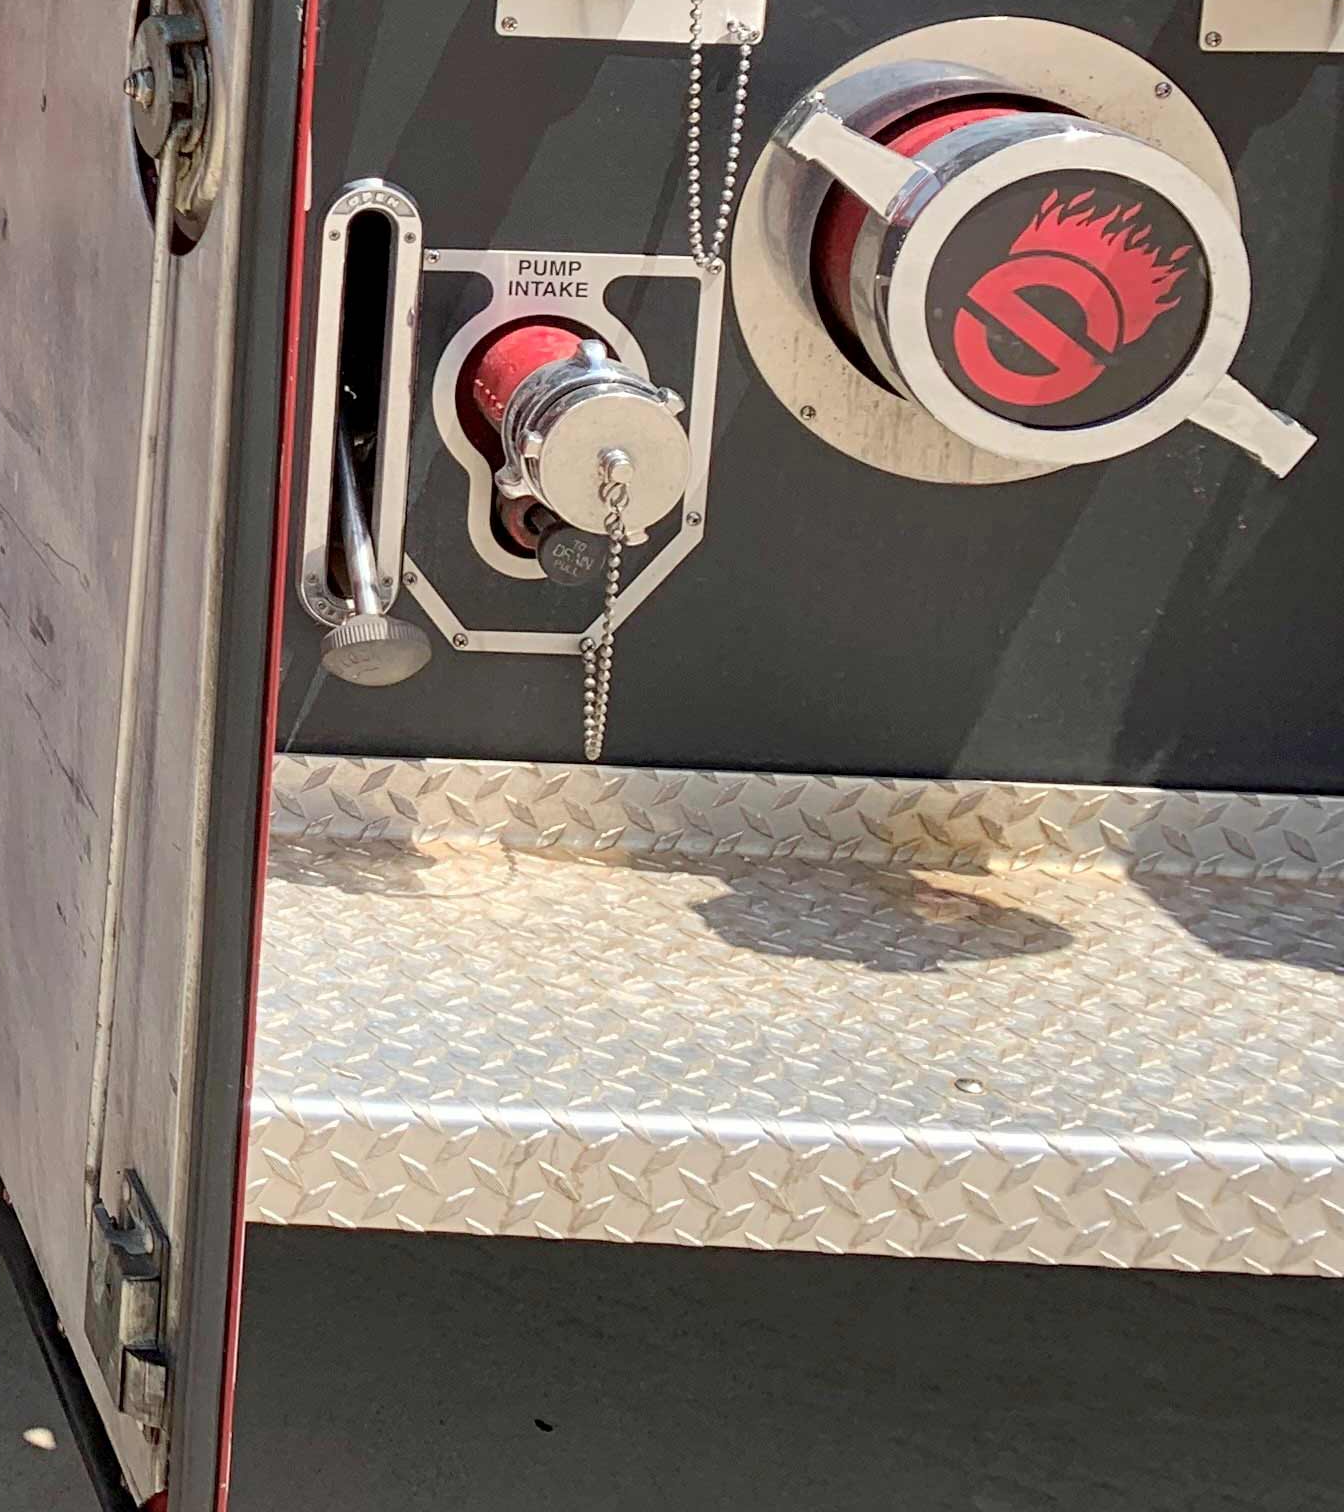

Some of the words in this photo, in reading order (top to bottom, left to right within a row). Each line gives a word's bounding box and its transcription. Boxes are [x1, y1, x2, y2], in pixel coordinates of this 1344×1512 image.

[348, 191, 400, 208] OPEN
[518, 260, 582, 277] PUMP
[508, 280, 589, 298] INTAKE
[552, 543, 594, 570] DRIN
